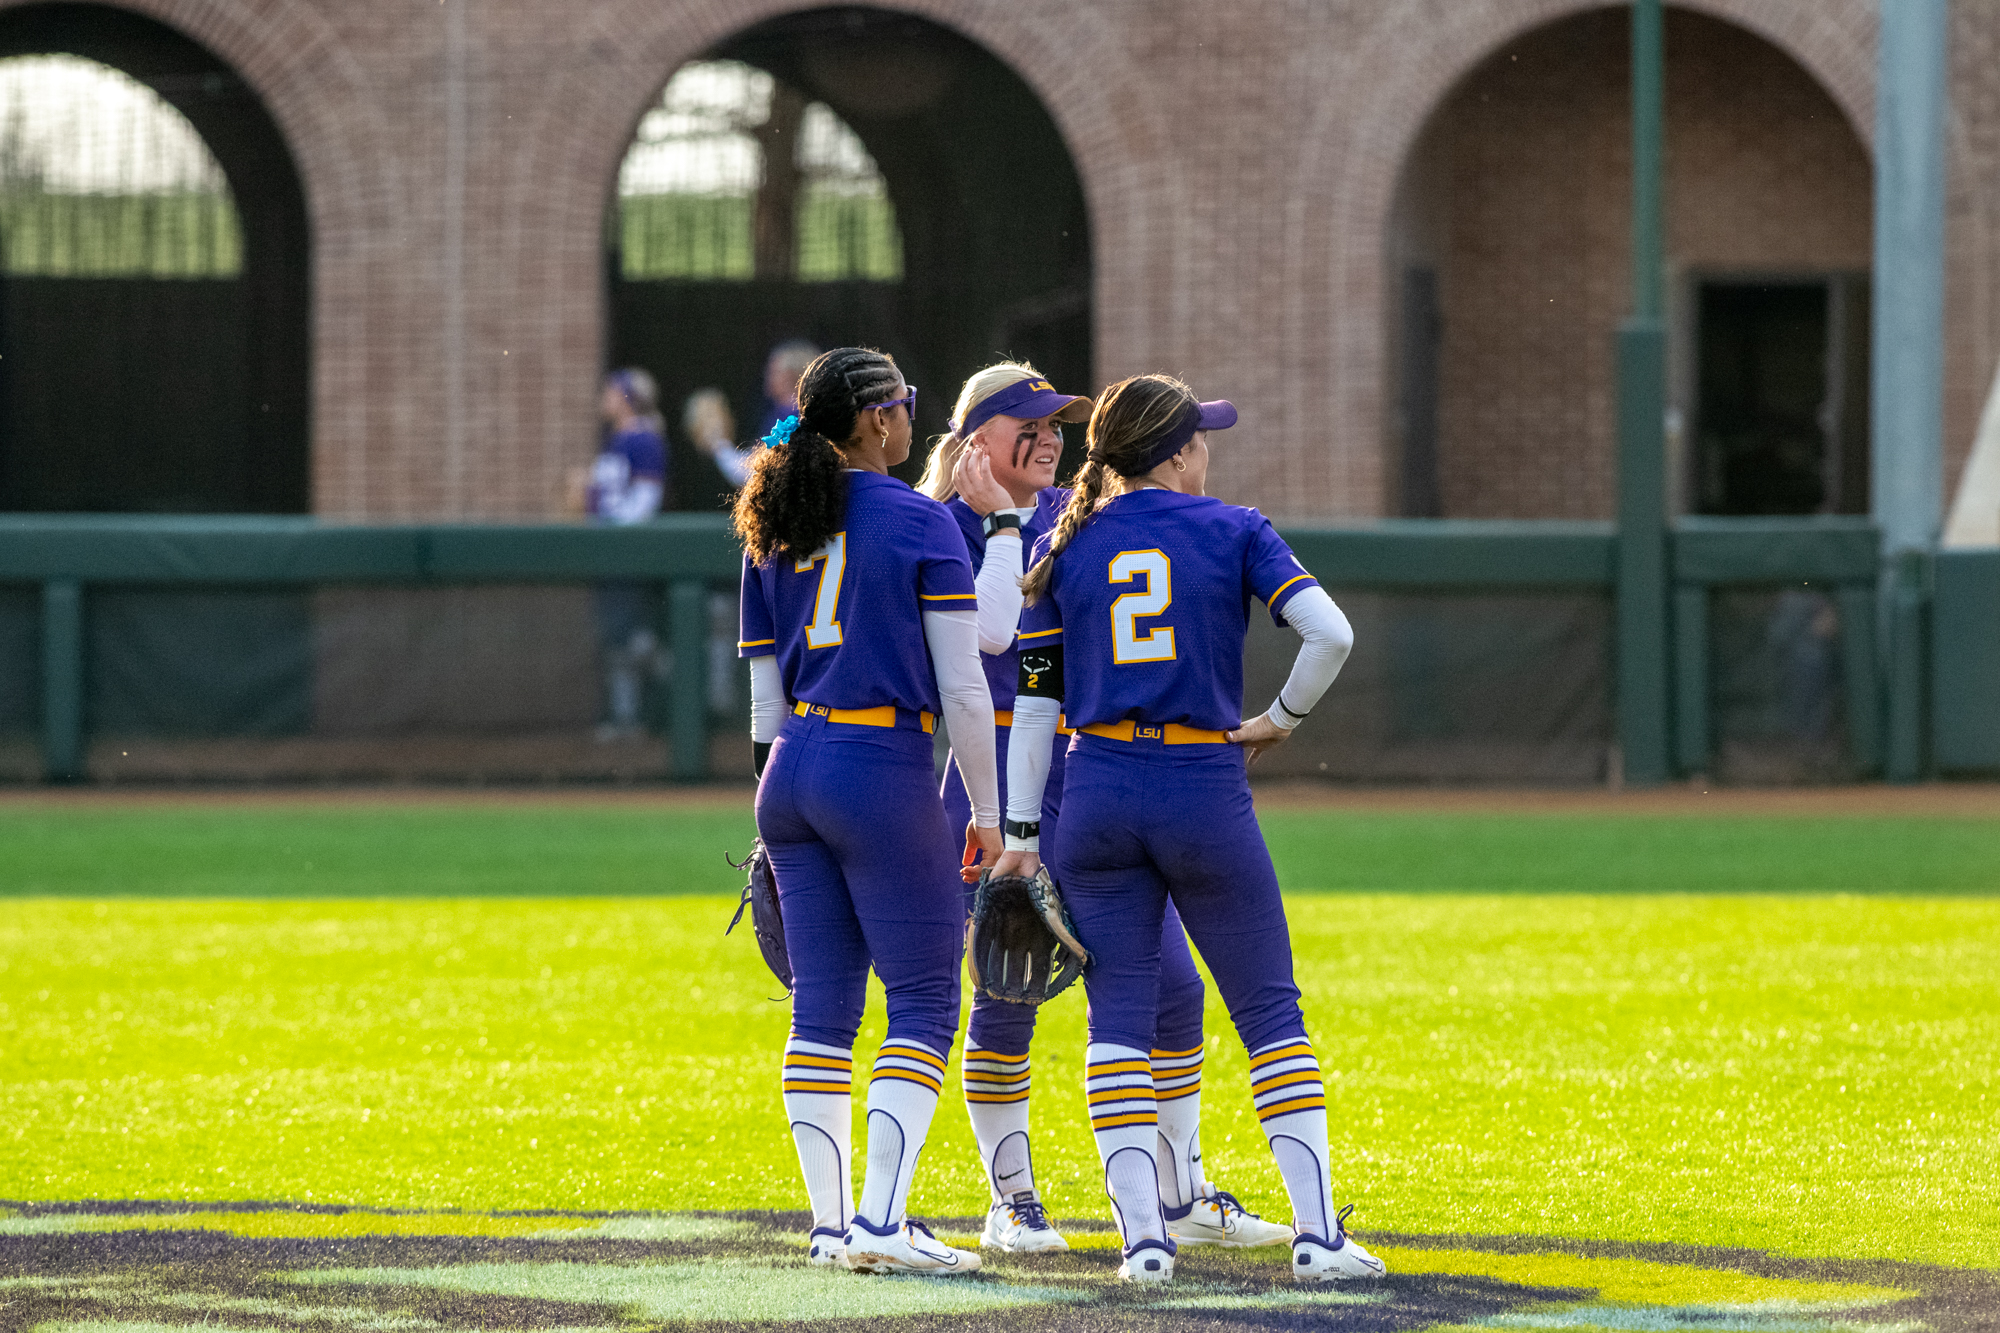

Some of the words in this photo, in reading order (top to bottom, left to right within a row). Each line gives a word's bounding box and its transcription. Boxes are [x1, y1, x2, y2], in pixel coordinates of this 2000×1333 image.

[795, 531, 846, 650] 7
[1109, 548, 1177, 665] 2
[1027, 674, 1039, 689] 2
[810, 704, 829, 717] LSU
[1135, 727, 1161, 739] LSU
